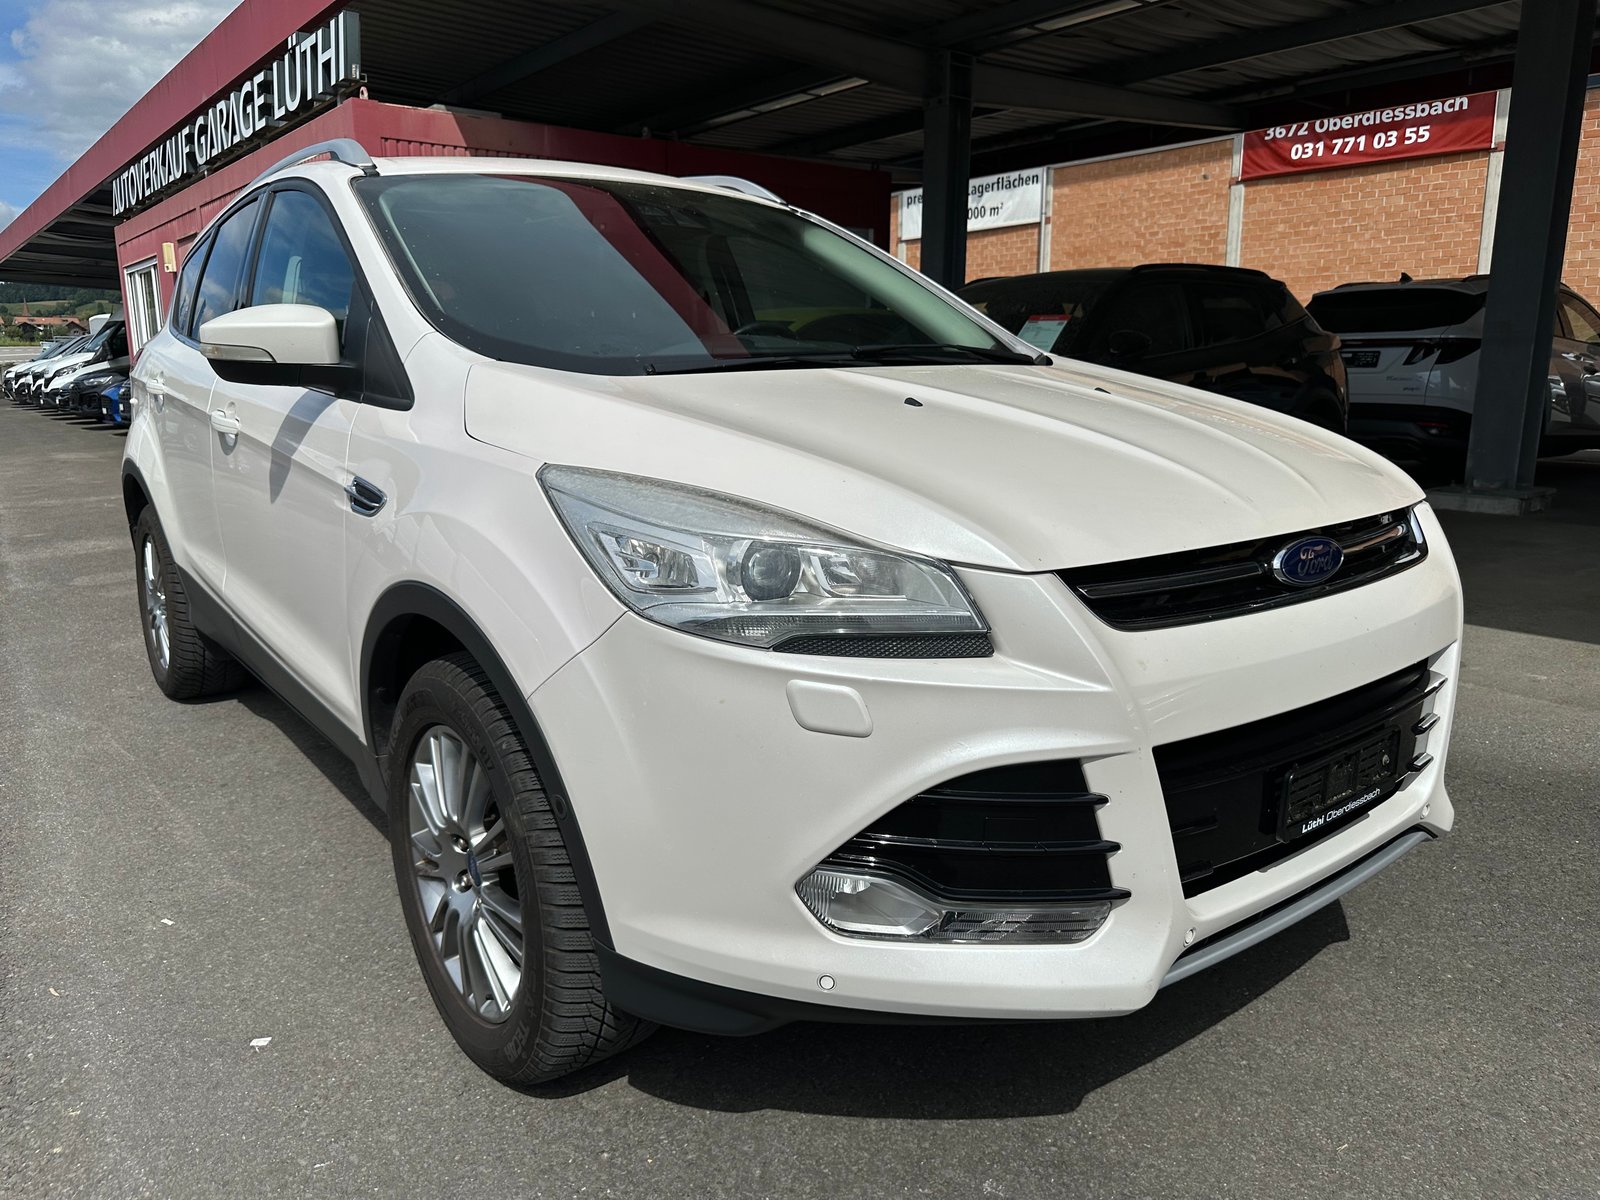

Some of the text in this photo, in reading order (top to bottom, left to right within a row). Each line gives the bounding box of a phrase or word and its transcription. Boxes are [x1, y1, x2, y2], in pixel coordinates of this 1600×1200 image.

[112, 10, 346, 217] AUTOVERKAUF GARAGE LÜTHI
[1290, 125, 1431, 160] 031 771 03 55
[967, 173, 1039, 198] agerflächen
[1297, 544, 1333, 577] Ford
[1301, 787, 1381, 834] Lüthi Oberdiessbach
